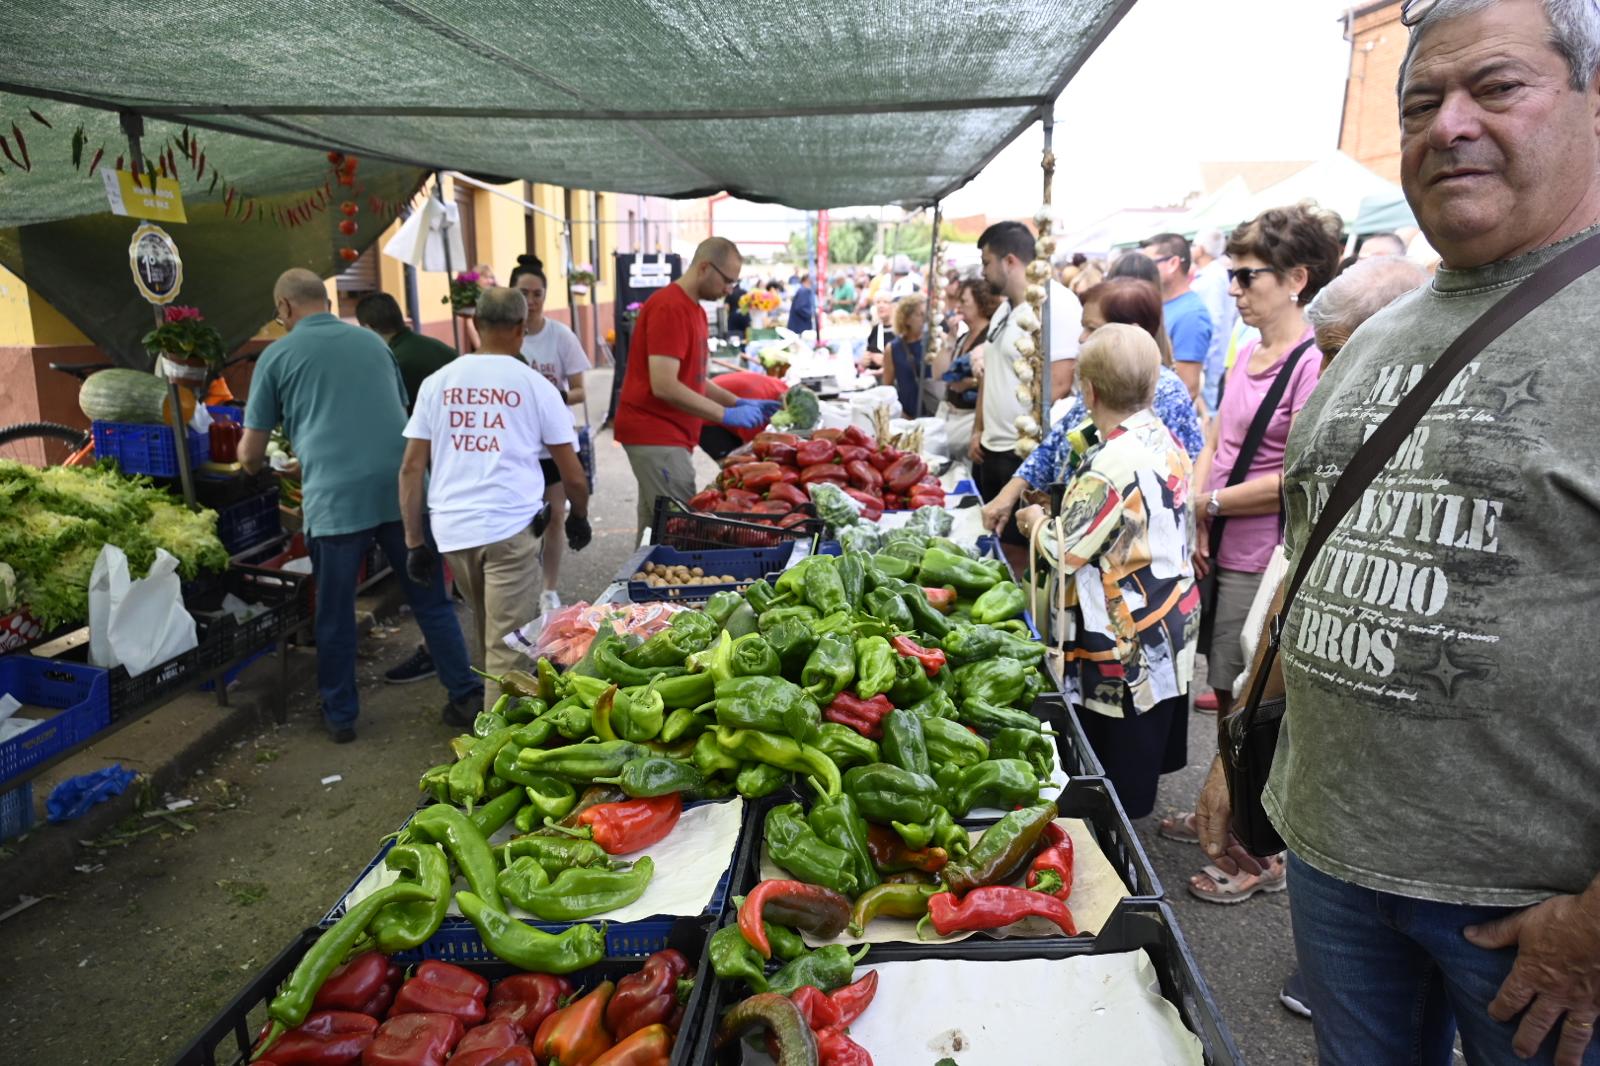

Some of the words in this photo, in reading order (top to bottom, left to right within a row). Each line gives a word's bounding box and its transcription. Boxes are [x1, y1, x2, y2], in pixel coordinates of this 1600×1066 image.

[443, 387, 521, 408] FRESNO
[1362, 362, 1480, 406] MAE
[449, 411, 476, 428] DE
[483, 412, 506, 429] LA
[451, 434, 500, 452] VEGA
[1363, 424, 1430, 470] OR
[1296, 608, 1398, 677] BROS
